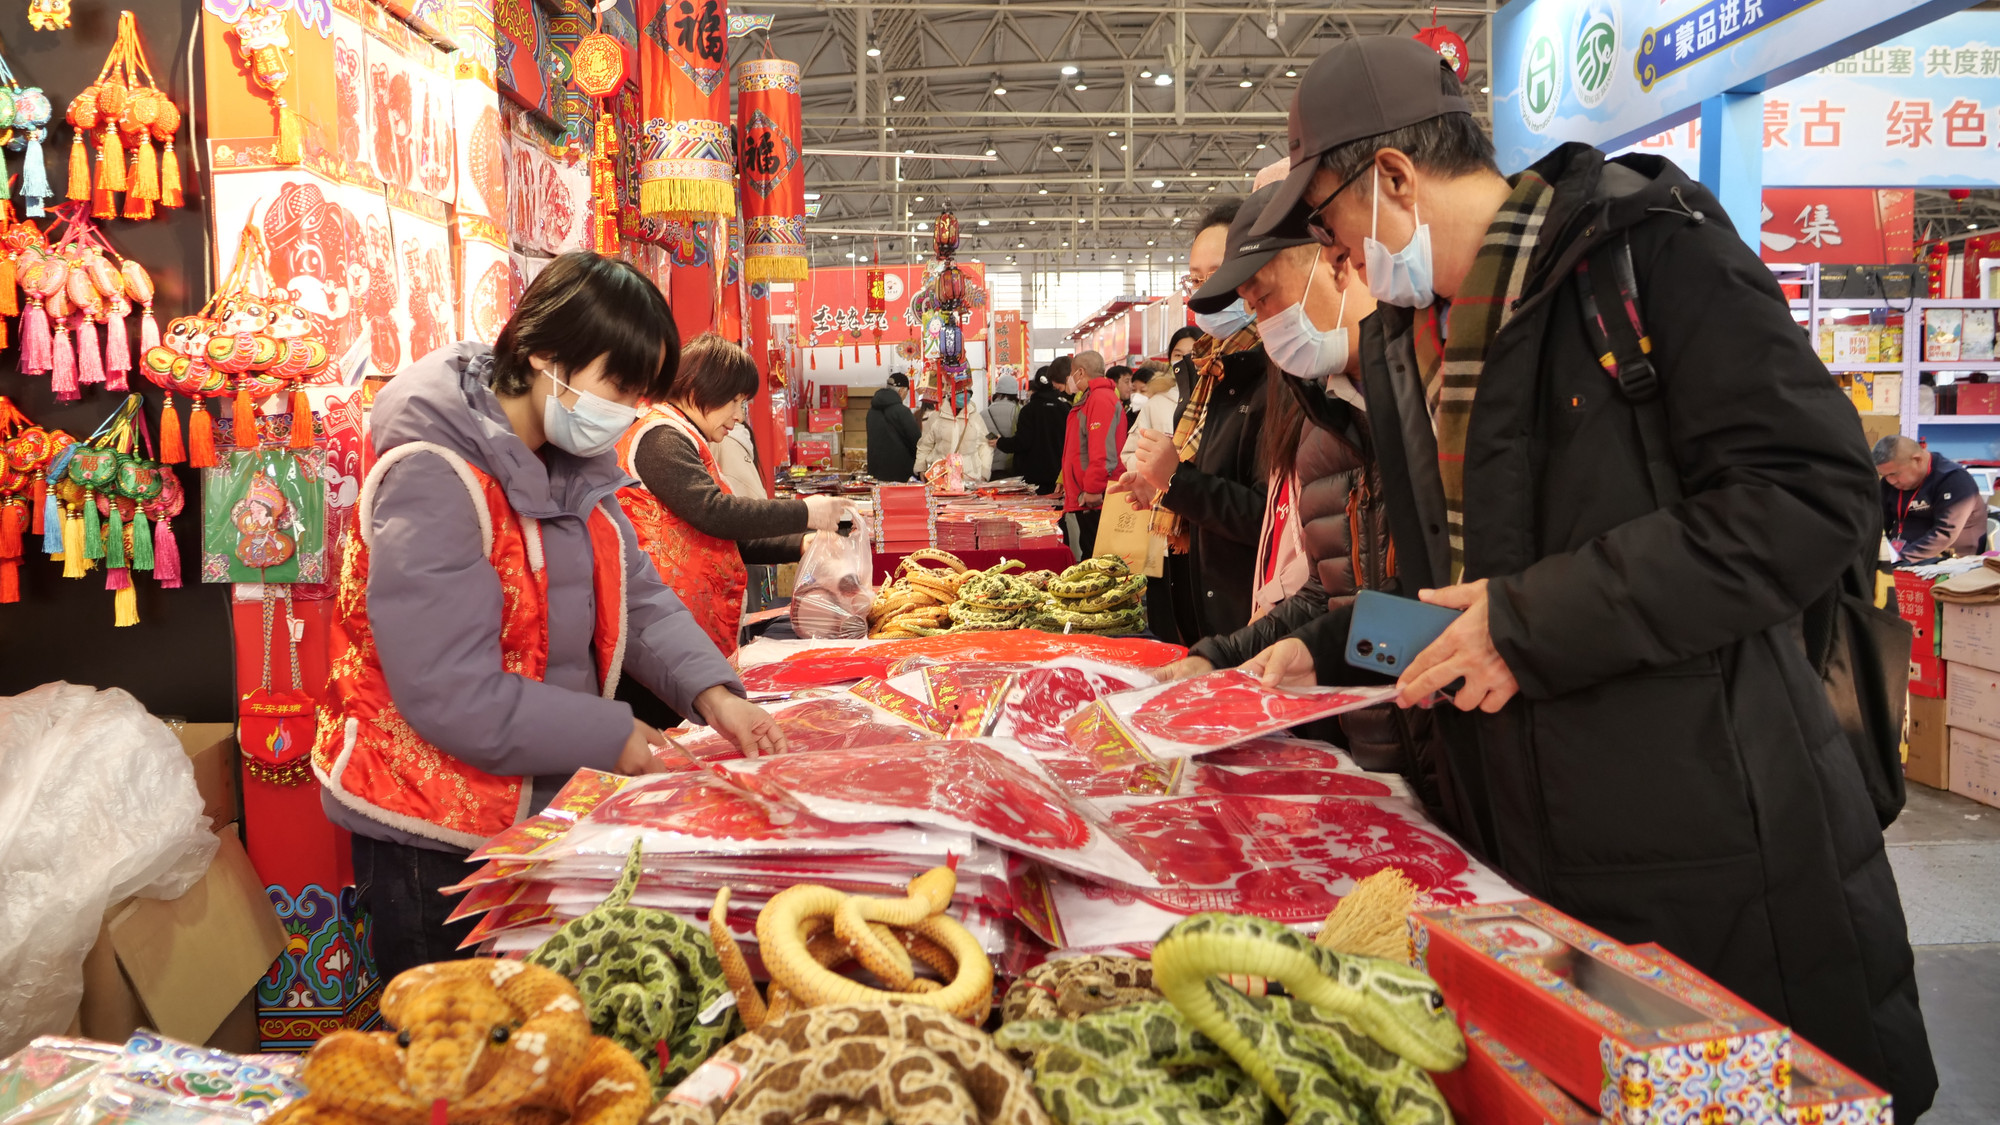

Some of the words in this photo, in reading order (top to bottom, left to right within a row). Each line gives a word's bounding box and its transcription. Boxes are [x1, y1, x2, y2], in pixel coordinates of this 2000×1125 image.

[674, 0, 723, 63] 福
[1886, 100, 1987, 147] 绿色
[745, 131, 780, 174] 福
[81, 455, 99, 472] 福
[135, 467, 153, 485] 福
